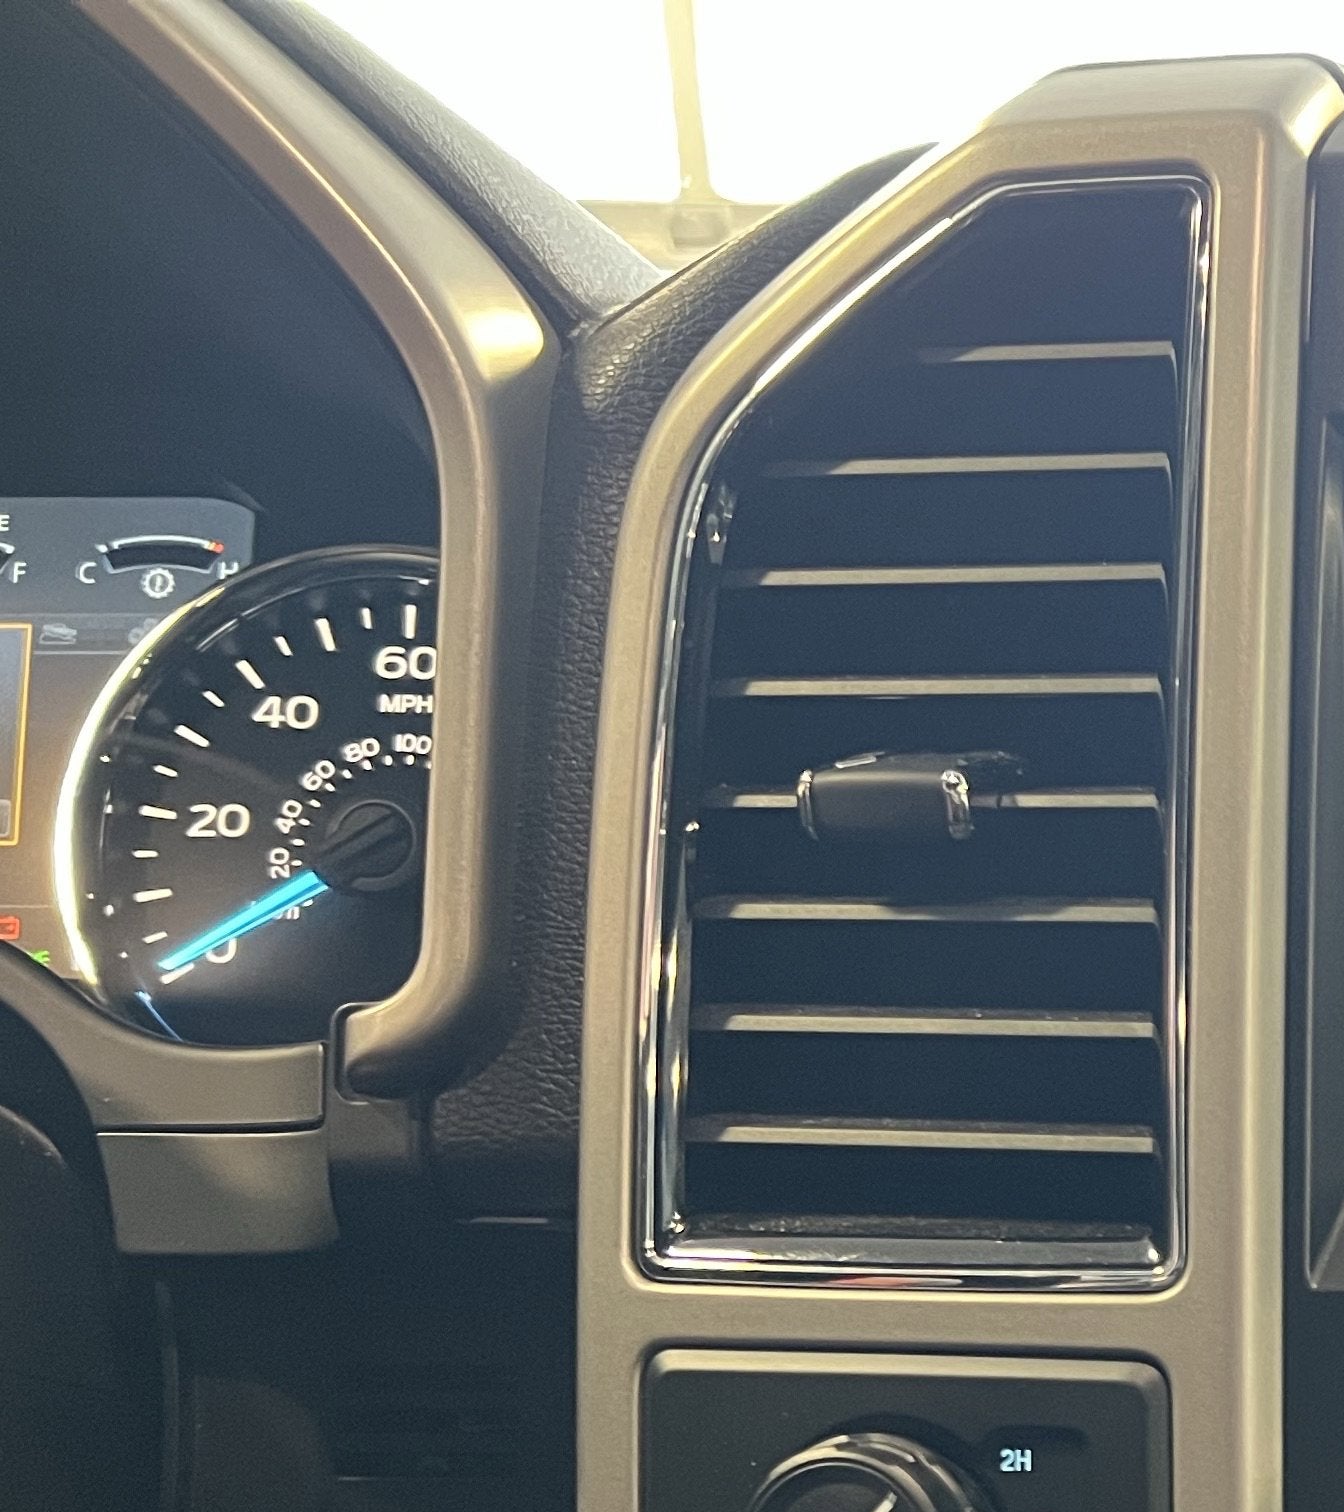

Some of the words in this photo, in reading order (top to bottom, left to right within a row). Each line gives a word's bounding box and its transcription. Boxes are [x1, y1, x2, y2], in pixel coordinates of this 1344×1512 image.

[12, 561, 27, 584] F
[374, 645, 437, 682] 60
[251, 695, 319, 730] 40
[378, 692, 434, 715] MPH
[342, 736, 381, 764] 80
[301, 759, 337, 793] 60
[185, 803, 251, 838] 20
[275, 799, 303, 835] 40
[268, 846, 292, 880] 20
[999, 1448, 1032, 1472] 2H
